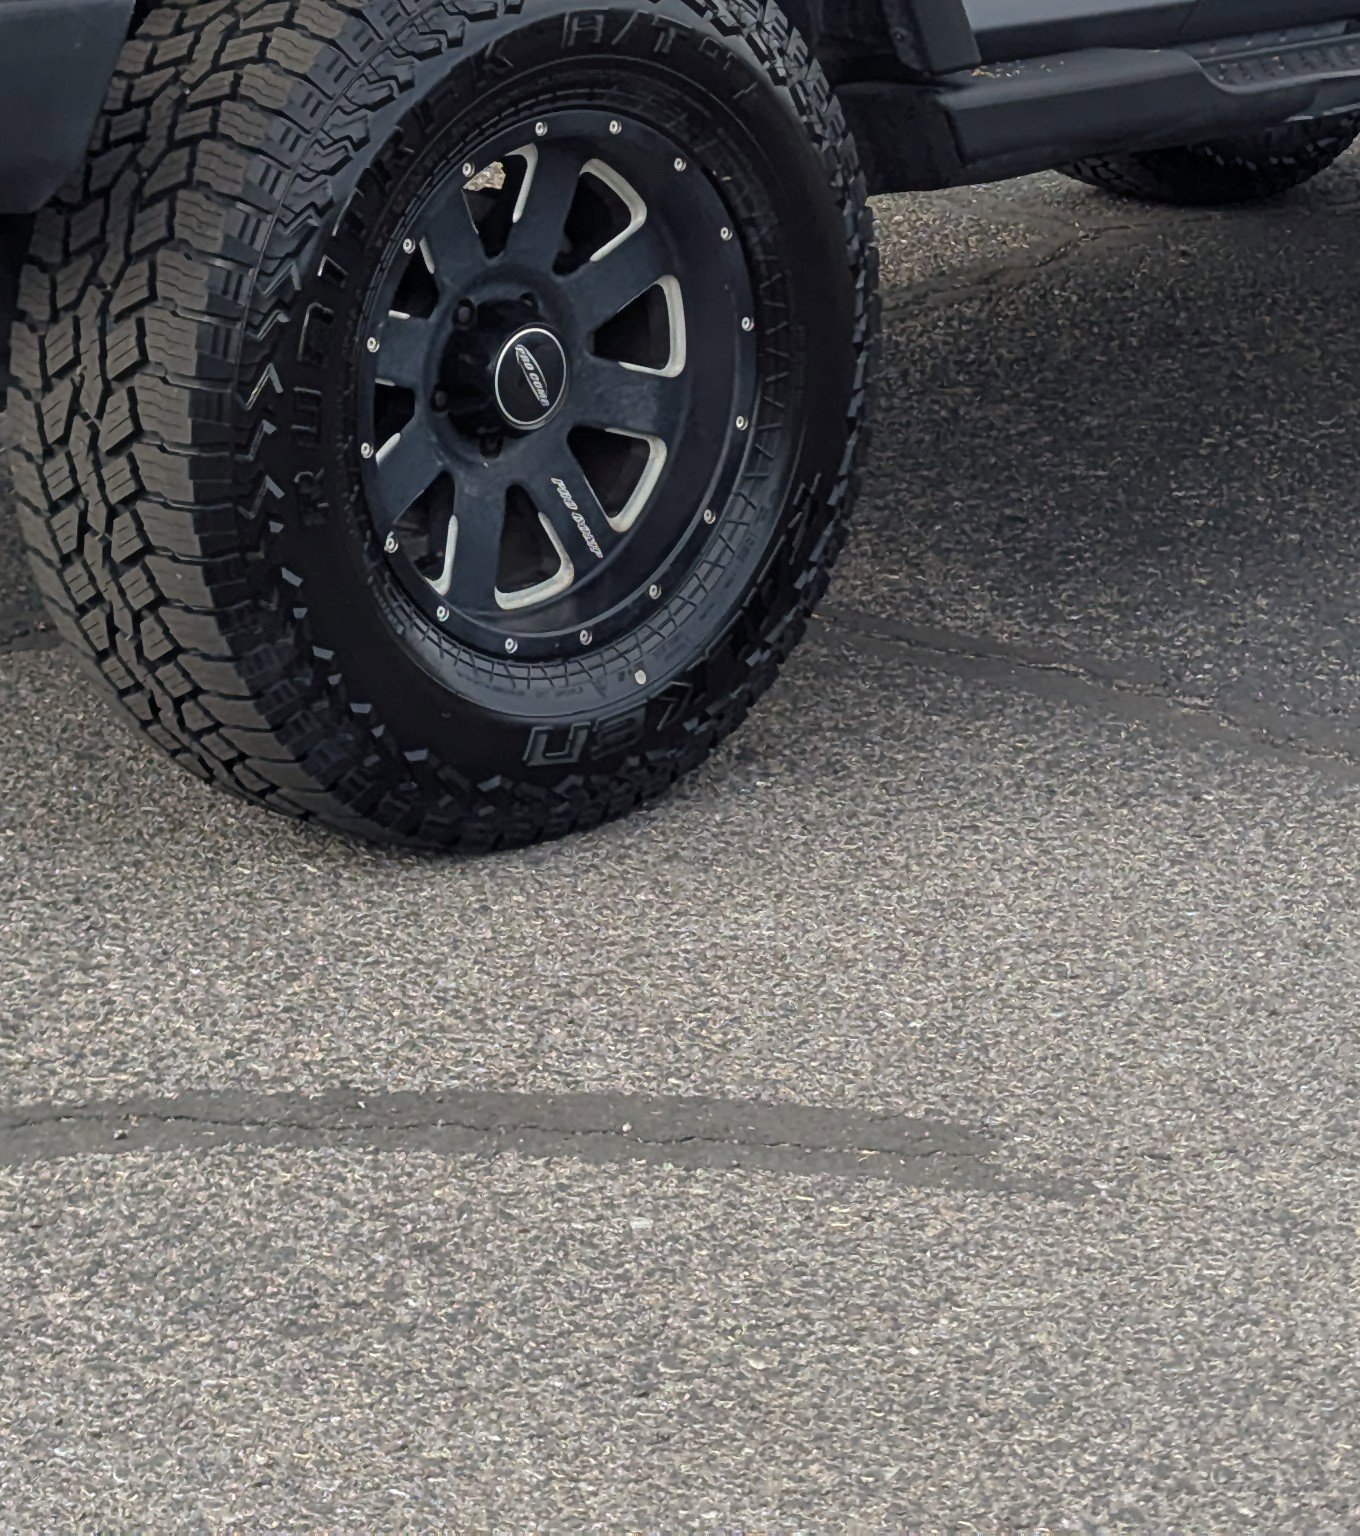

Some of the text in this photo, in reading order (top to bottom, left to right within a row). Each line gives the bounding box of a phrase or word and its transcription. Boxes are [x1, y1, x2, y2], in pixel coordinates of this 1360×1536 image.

[514, 345, 550, 407] PRO COMP
[550, 477, 604, 559] PRO COMP
